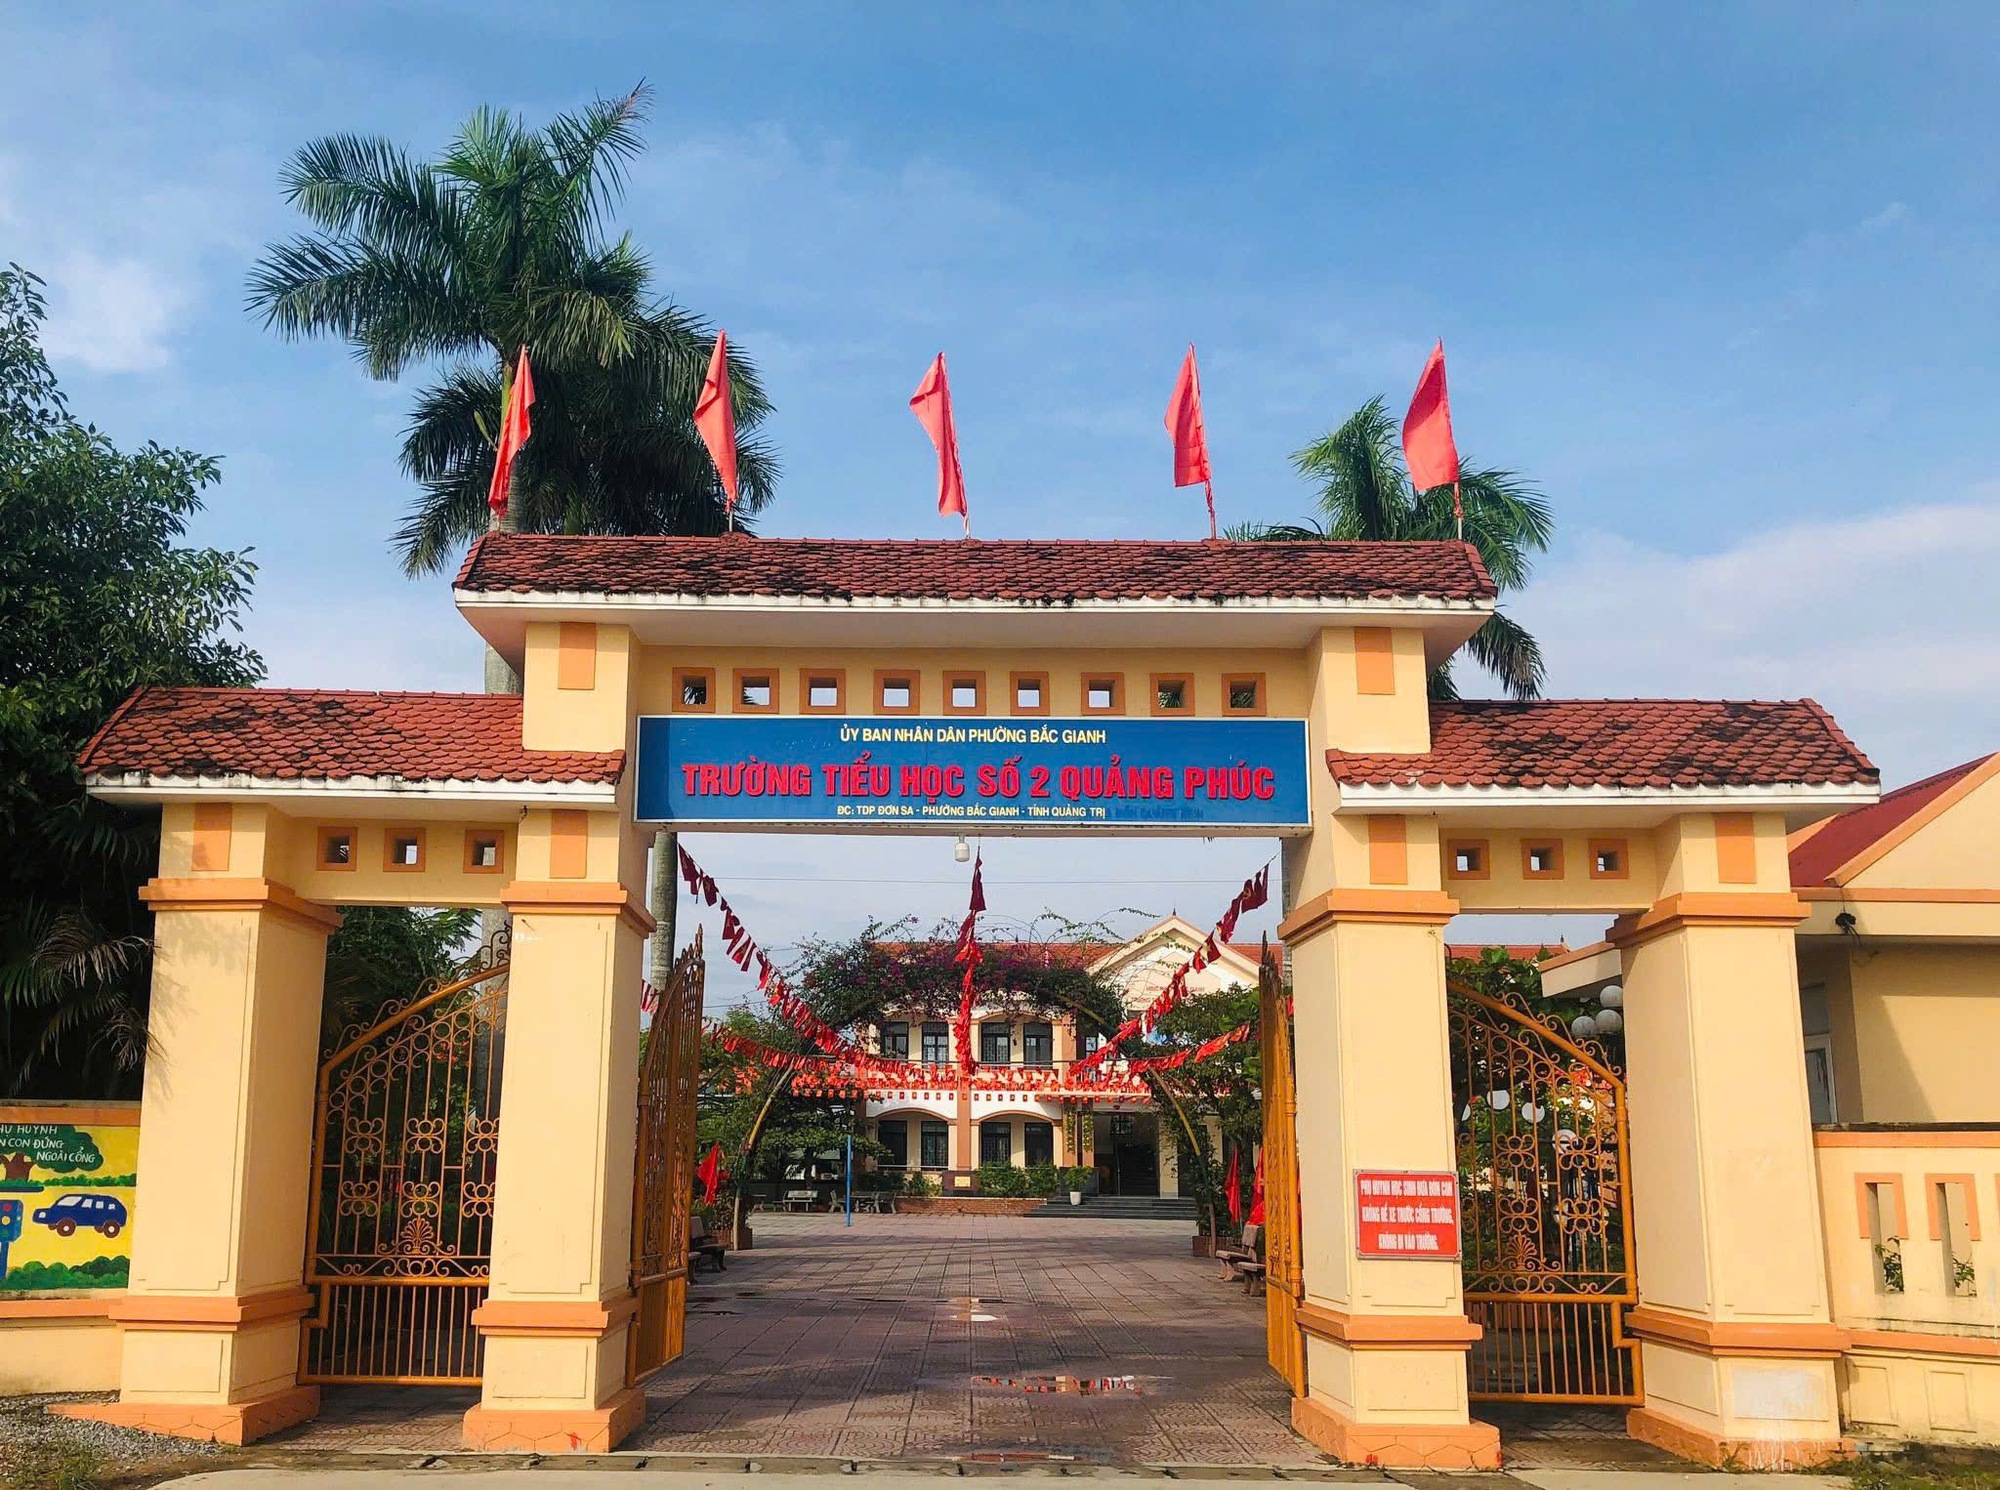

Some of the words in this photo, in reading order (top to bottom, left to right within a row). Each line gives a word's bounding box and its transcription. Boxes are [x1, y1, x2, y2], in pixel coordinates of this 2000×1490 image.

[841, 724, 859, 742] ỦY
[863, 728, 891, 742] BAN
[895, 726, 933, 742] NHÂN
[937, 726, 965, 742] DÂN
[969, 725, 1026, 743] PHƯỜNG
[1030, 724, 1058, 743] BẮC
[1062, 730, 1106, 743] GIANH
[682, 756, 811, 797] TRƯỜNG
[823, 751, 890, 797] TIỂU
[901, 765, 964, 803] HỌC
[977, 756, 1022, 797] SỐ
[1030, 766, 1050, 797] 2
[1061, 755, 1173, 800] QUẢNG
[1185, 760, 1274, 800] PHÚC
[837, 805, 854, 815] ĐC:
[856, 805, 876, 815] TDP
[878, 805, 899, 815] ĐƠN
[901, 806, 913, 815] SA
[922, 804, 964, 816] PHƯỜNG
[967, 803, 986, 816] BẮC
[989, 806, 1019, 817] GIANH
[1052, 804, 1087, 817] QUẢNG
[17, 1125, 58, 1135] HUYNH
[8, 1138, 31, 1148] CON
[33, 1136, 65, 1149] ĐỨNG
[36, 1150, 67, 1161] NGOÀI
[69, 1146, 95, 1163] CỔNG
